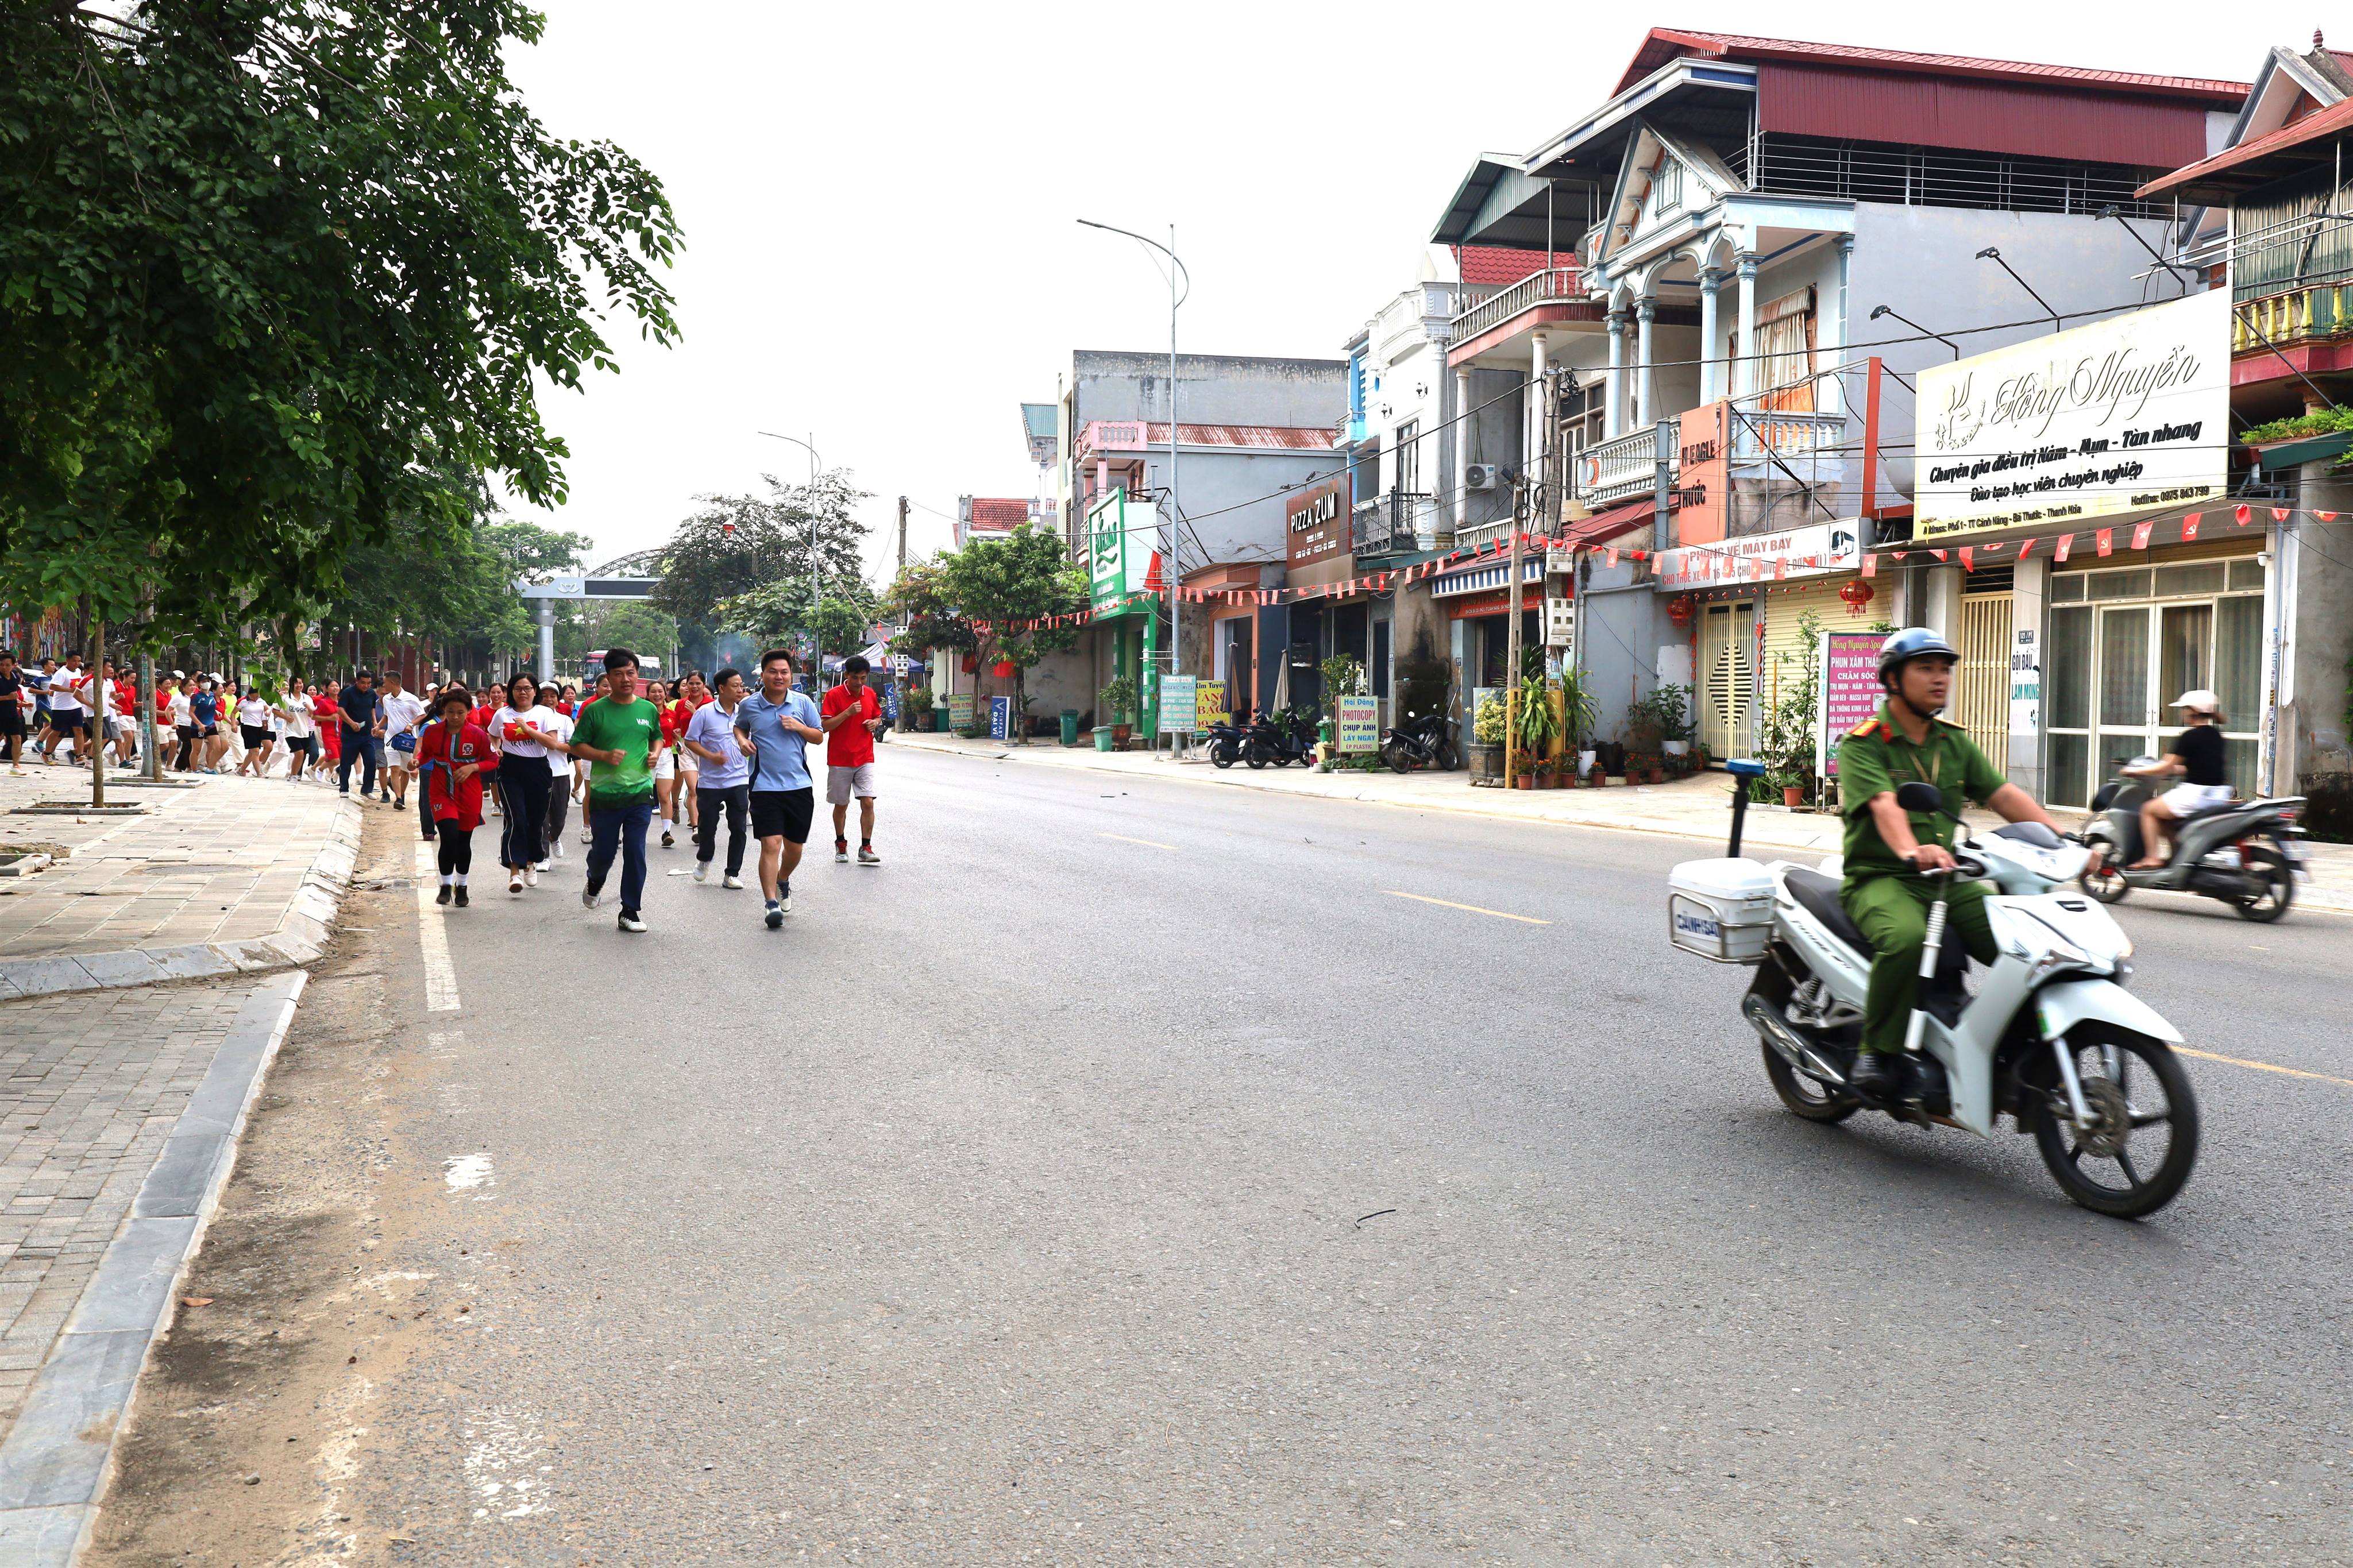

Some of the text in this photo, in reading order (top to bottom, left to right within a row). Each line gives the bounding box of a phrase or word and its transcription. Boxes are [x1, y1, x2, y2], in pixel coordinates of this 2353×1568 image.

[1690, 439, 1715, 465] EAGLE
[1930, 421, 2202, 482] Chuyên gia điều trị Nám Mụn Tàn nhang
[1971, 461, 2143, 502] Đào tạo học viên chuyên nghiệp
[2131, 495, 2159, 505] Hotline:
[2161, 489, 2178, 501] 0975
[1291, 492, 1336, 534] PIZZA ZUM
[1743, 539, 1768, 555] MÁY
[1770, 537, 1792, 551] BAY
[1662, 574, 1675, 585] CHO
[1831, 638, 1846, 651] Hồng
[1870, 639, 1881, 651] Spa
[1831, 656, 1847, 667] PHUN
[1850, 655, 1863, 667] XĂM
[2012, 651, 2021, 674] GỘI
[1837, 670, 1876, 679] CHĂM SÓC
[1838, 683, 1849, 691] MỤN
[2012, 680, 2039, 700] LÀM MÓNG
[1357, 698, 1374, 706] Đăng
[1862, 705, 1870, 713] LẠC
[1342, 710, 1375, 721] PHOTOCOPY
[1343, 721, 1376, 732] CHỤP ẢNH
[1343, 733, 1355, 741] LẤY
